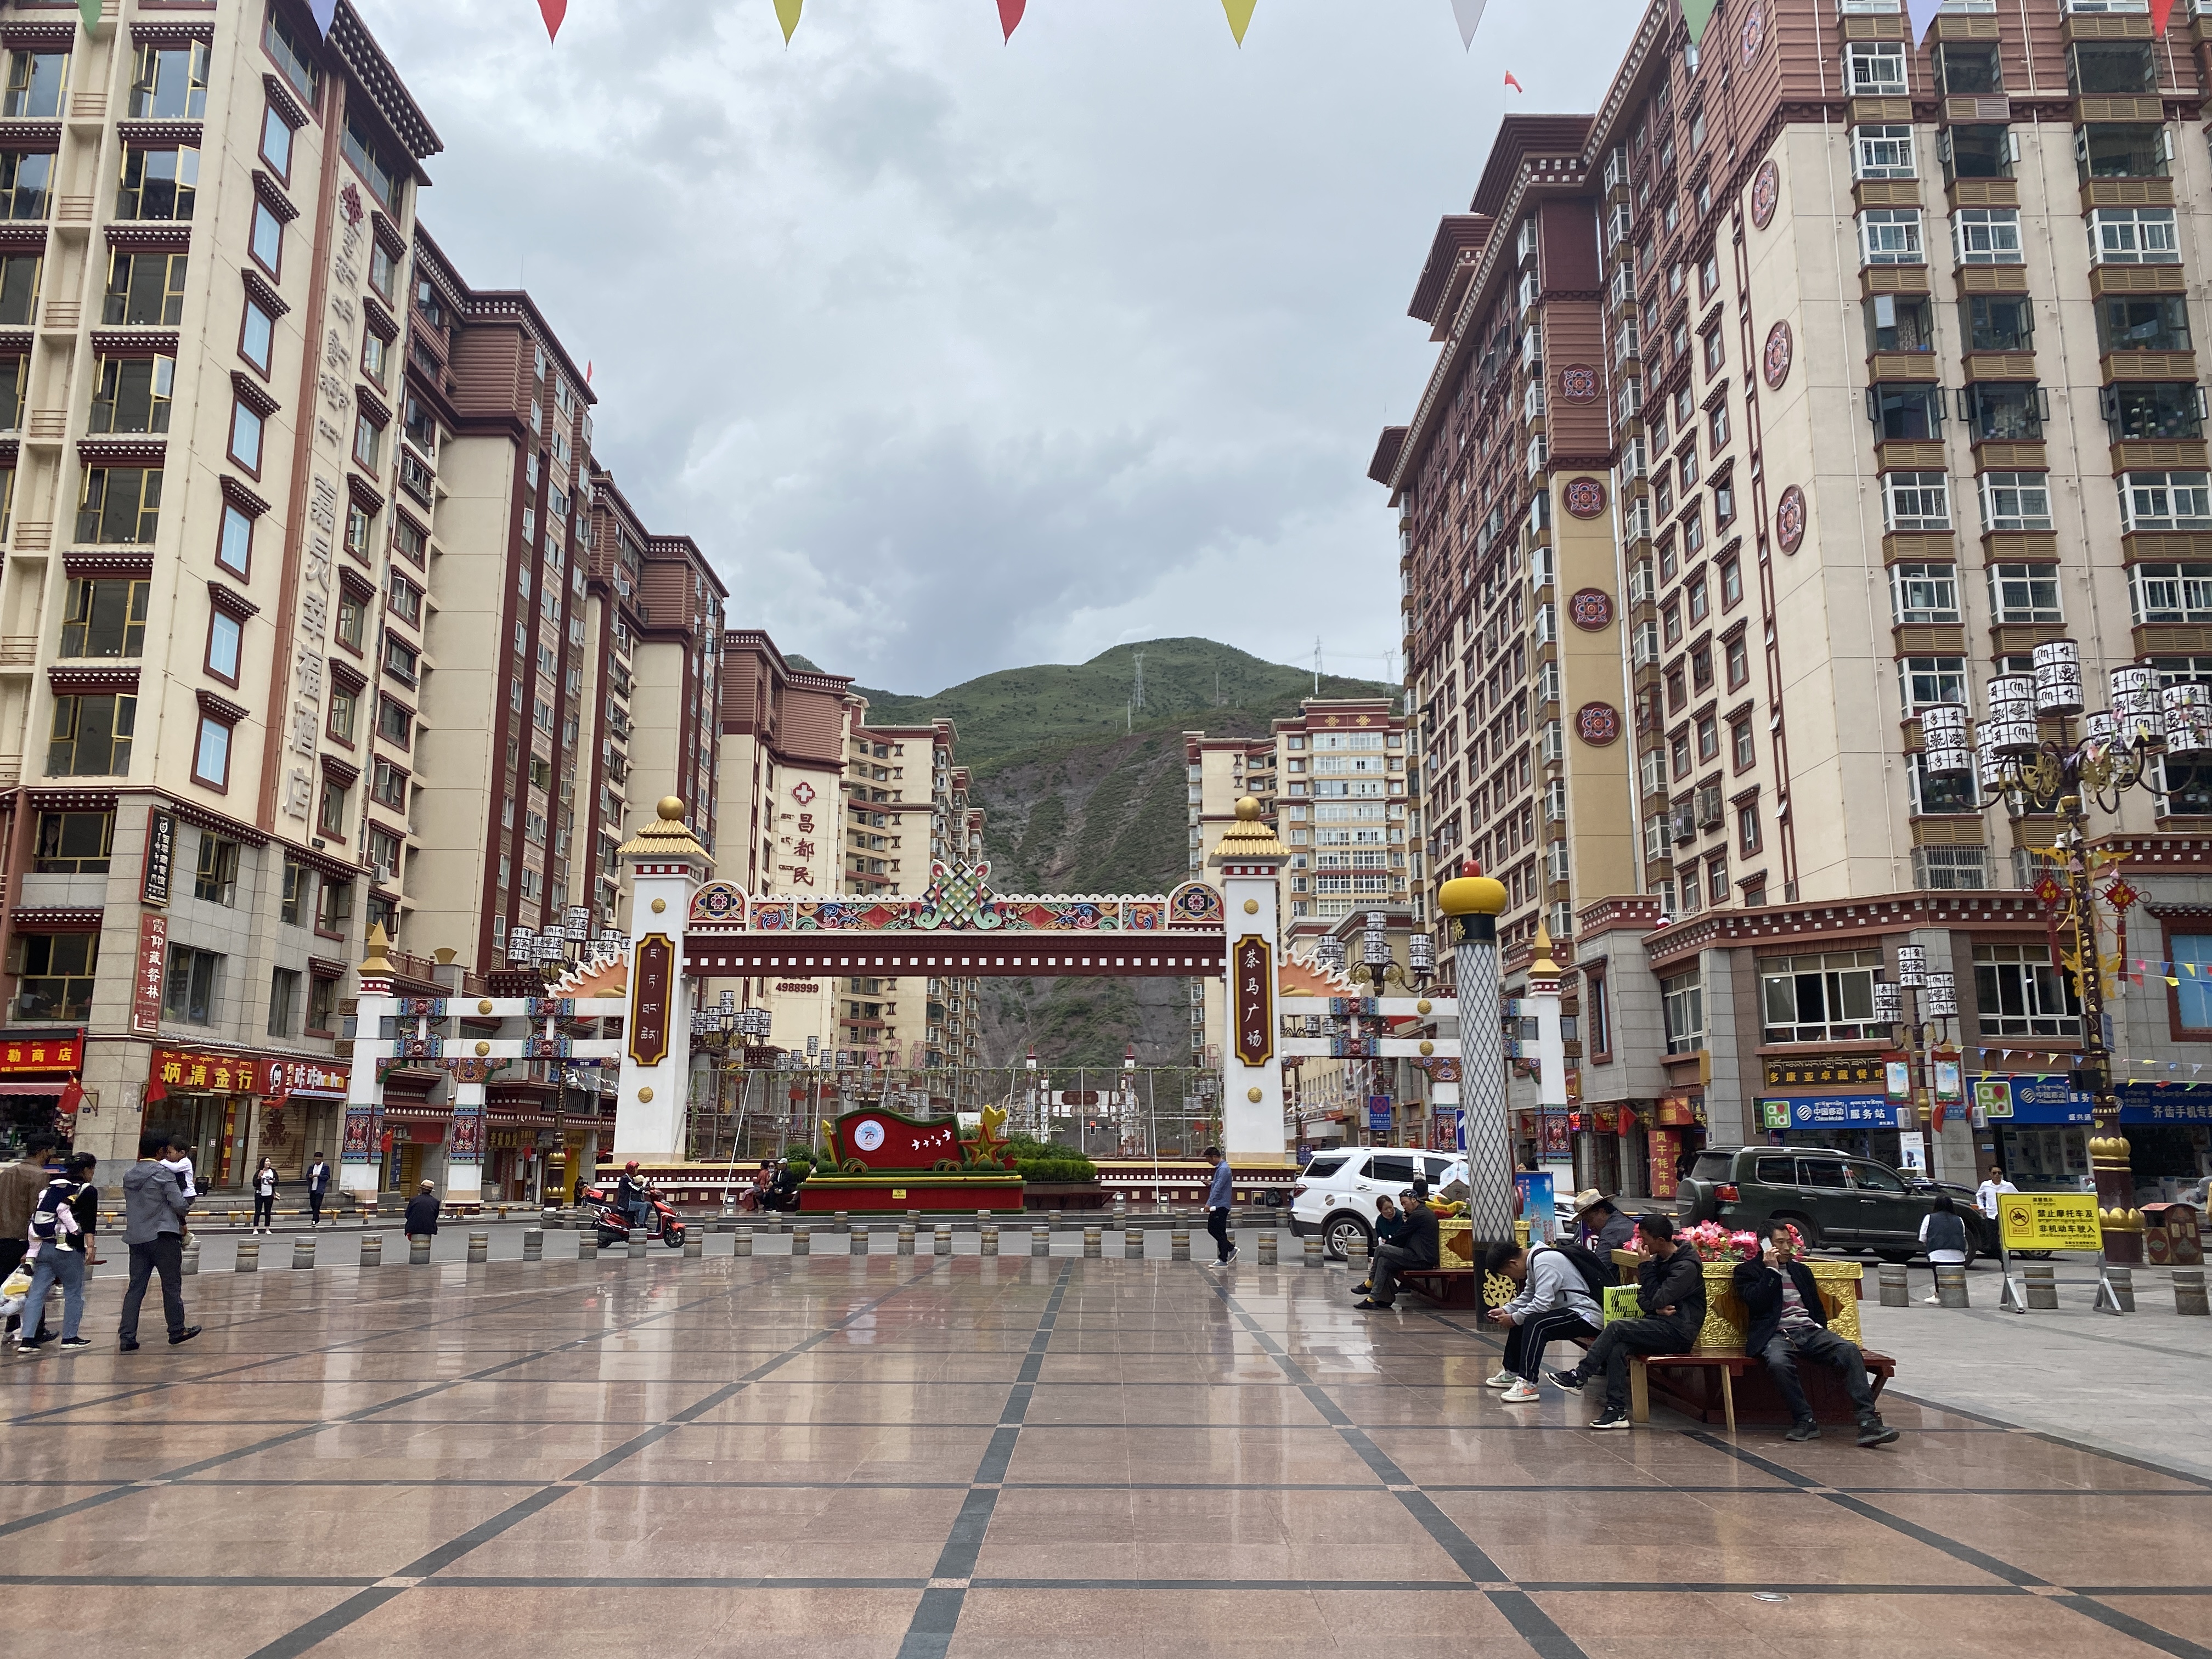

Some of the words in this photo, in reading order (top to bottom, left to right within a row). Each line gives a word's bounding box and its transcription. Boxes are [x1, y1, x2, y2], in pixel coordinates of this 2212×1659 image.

[283, 472, 337, 821] 嘉灵幸福酒店
[793, 813, 815, 886] 昌都民
[776, 982, 819, 993] 4988999
[1244, 949, 1262, 1047] 茶马广场
[162, 1062, 253, 1089] 炳清金行
[1770, 1069, 1884, 1083] 多康亚卓藏餐吧
[2070, 1093, 2090, 1103] 服务
[1850, 1109, 1886, 1119] 服务站
[1656, 1132, 1670, 1195] 风干牦牛肉
[2038, 1209, 2094, 1217] 禁止摩托车及
[2039, 1224, 2096, 1233] 非机动车驶入
